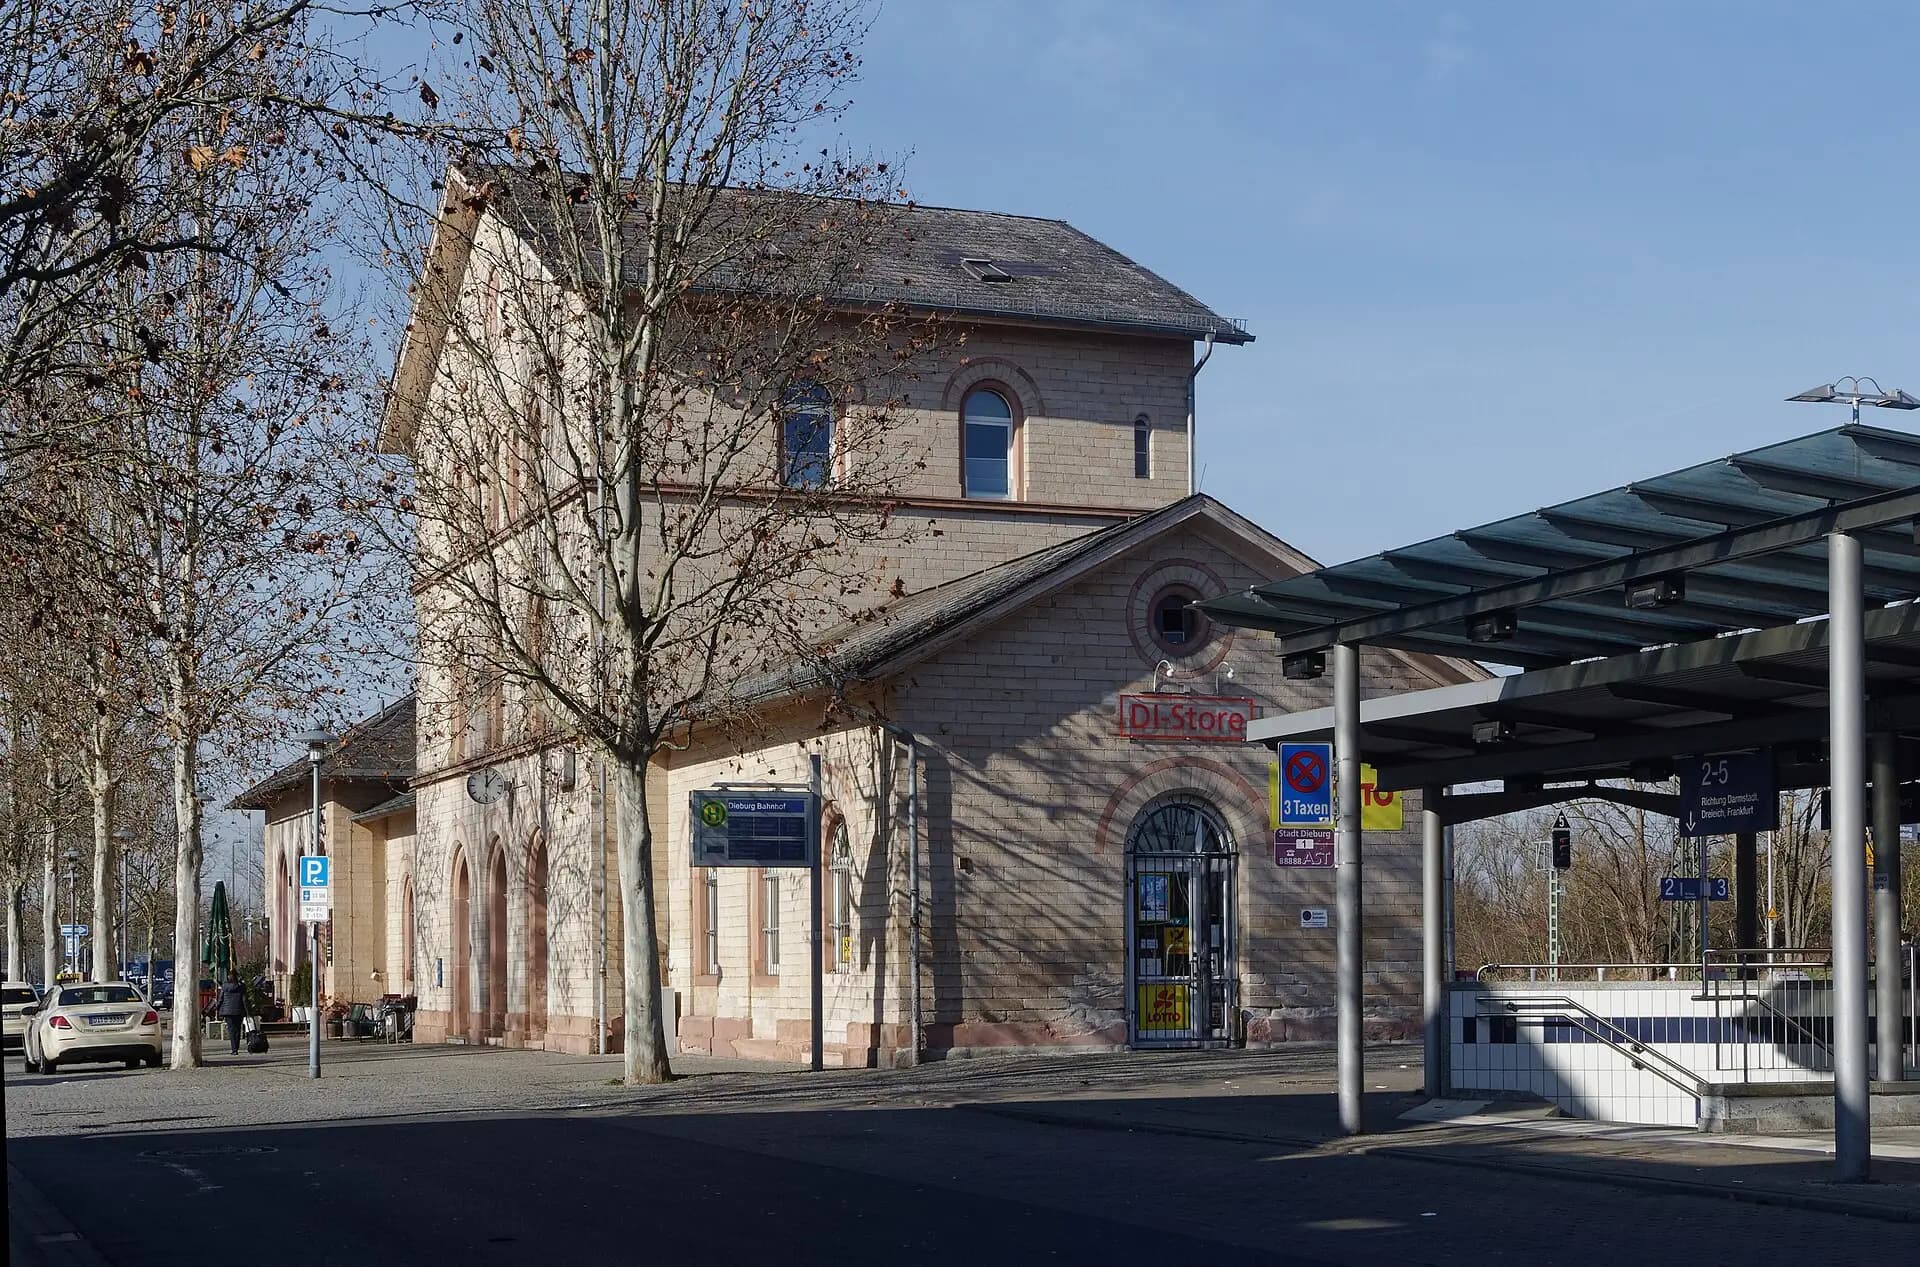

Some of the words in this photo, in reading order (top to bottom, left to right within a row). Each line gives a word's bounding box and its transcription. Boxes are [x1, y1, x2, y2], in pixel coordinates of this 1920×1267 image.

[1131, 703, 1246, 733] DI-Store
[1702, 760, 1728, 786] 2-5
[728, 802, 756, 811] Dieburg
[757, 802, 786, 810] Bahnhof
[1284, 799, 1291, 815] 3
[1293, 799, 1329, 815] Taxen
[1701, 796, 1726, 806] Richtung
[1727, 805, 1754, 817] Frankfurt
[1559, 815, 1565, 827] 5
[1278, 829, 1300, 838] Stadt
[1300, 829, 1331, 840] Dieburg
[307, 860, 323, 884] P
[1665, 878, 1674, 896] 2
[1717, 878, 1726, 896] 3
[1148, 1012, 1181, 1023] LOTTO
